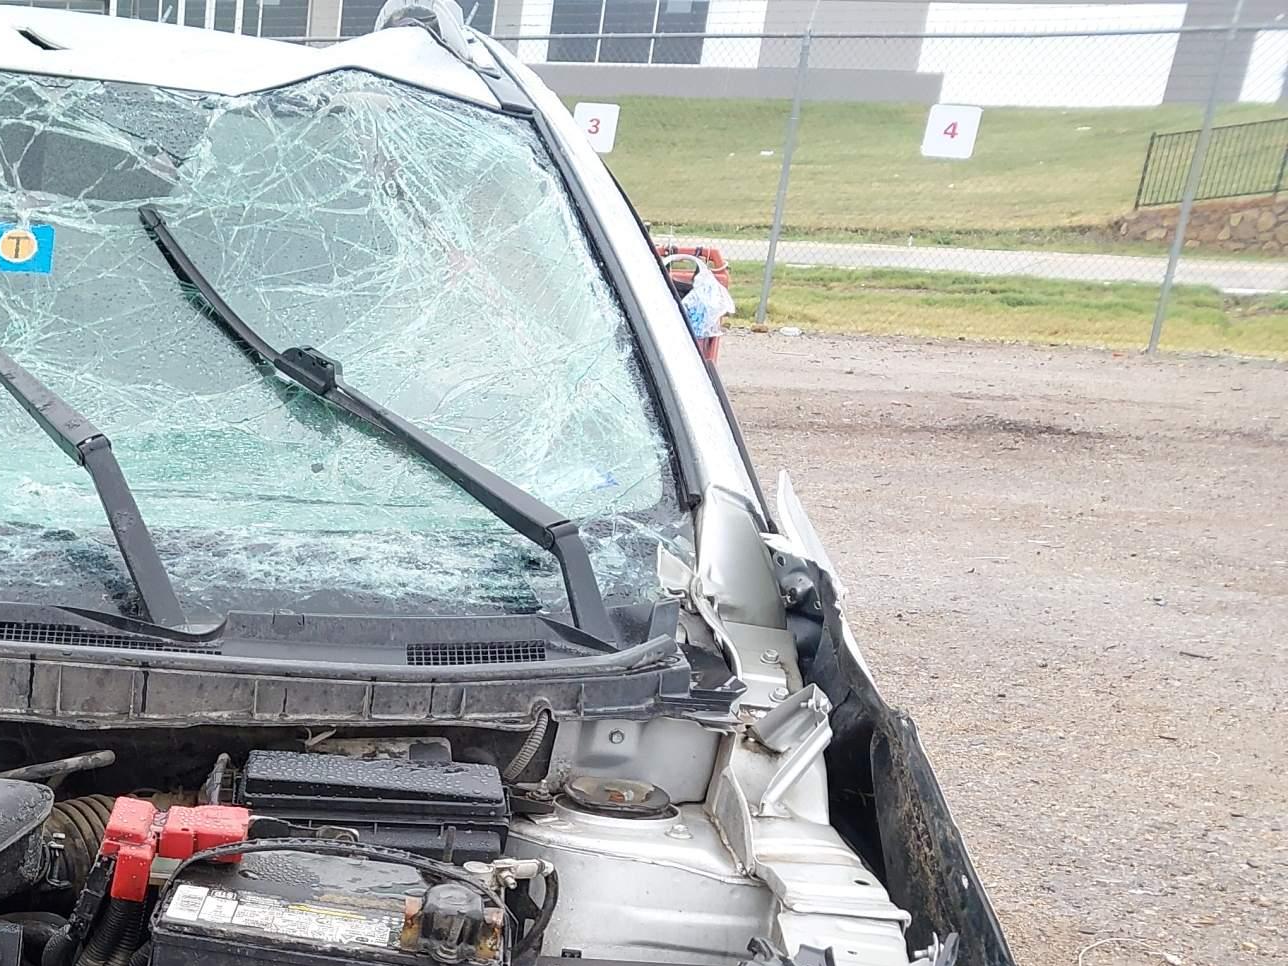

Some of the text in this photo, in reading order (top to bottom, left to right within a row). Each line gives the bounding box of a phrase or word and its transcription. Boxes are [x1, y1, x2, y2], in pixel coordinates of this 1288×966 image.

[587, 118, 601, 135] 3
[943, 121, 959, 139] 4
[7, 235, 30, 259] T
